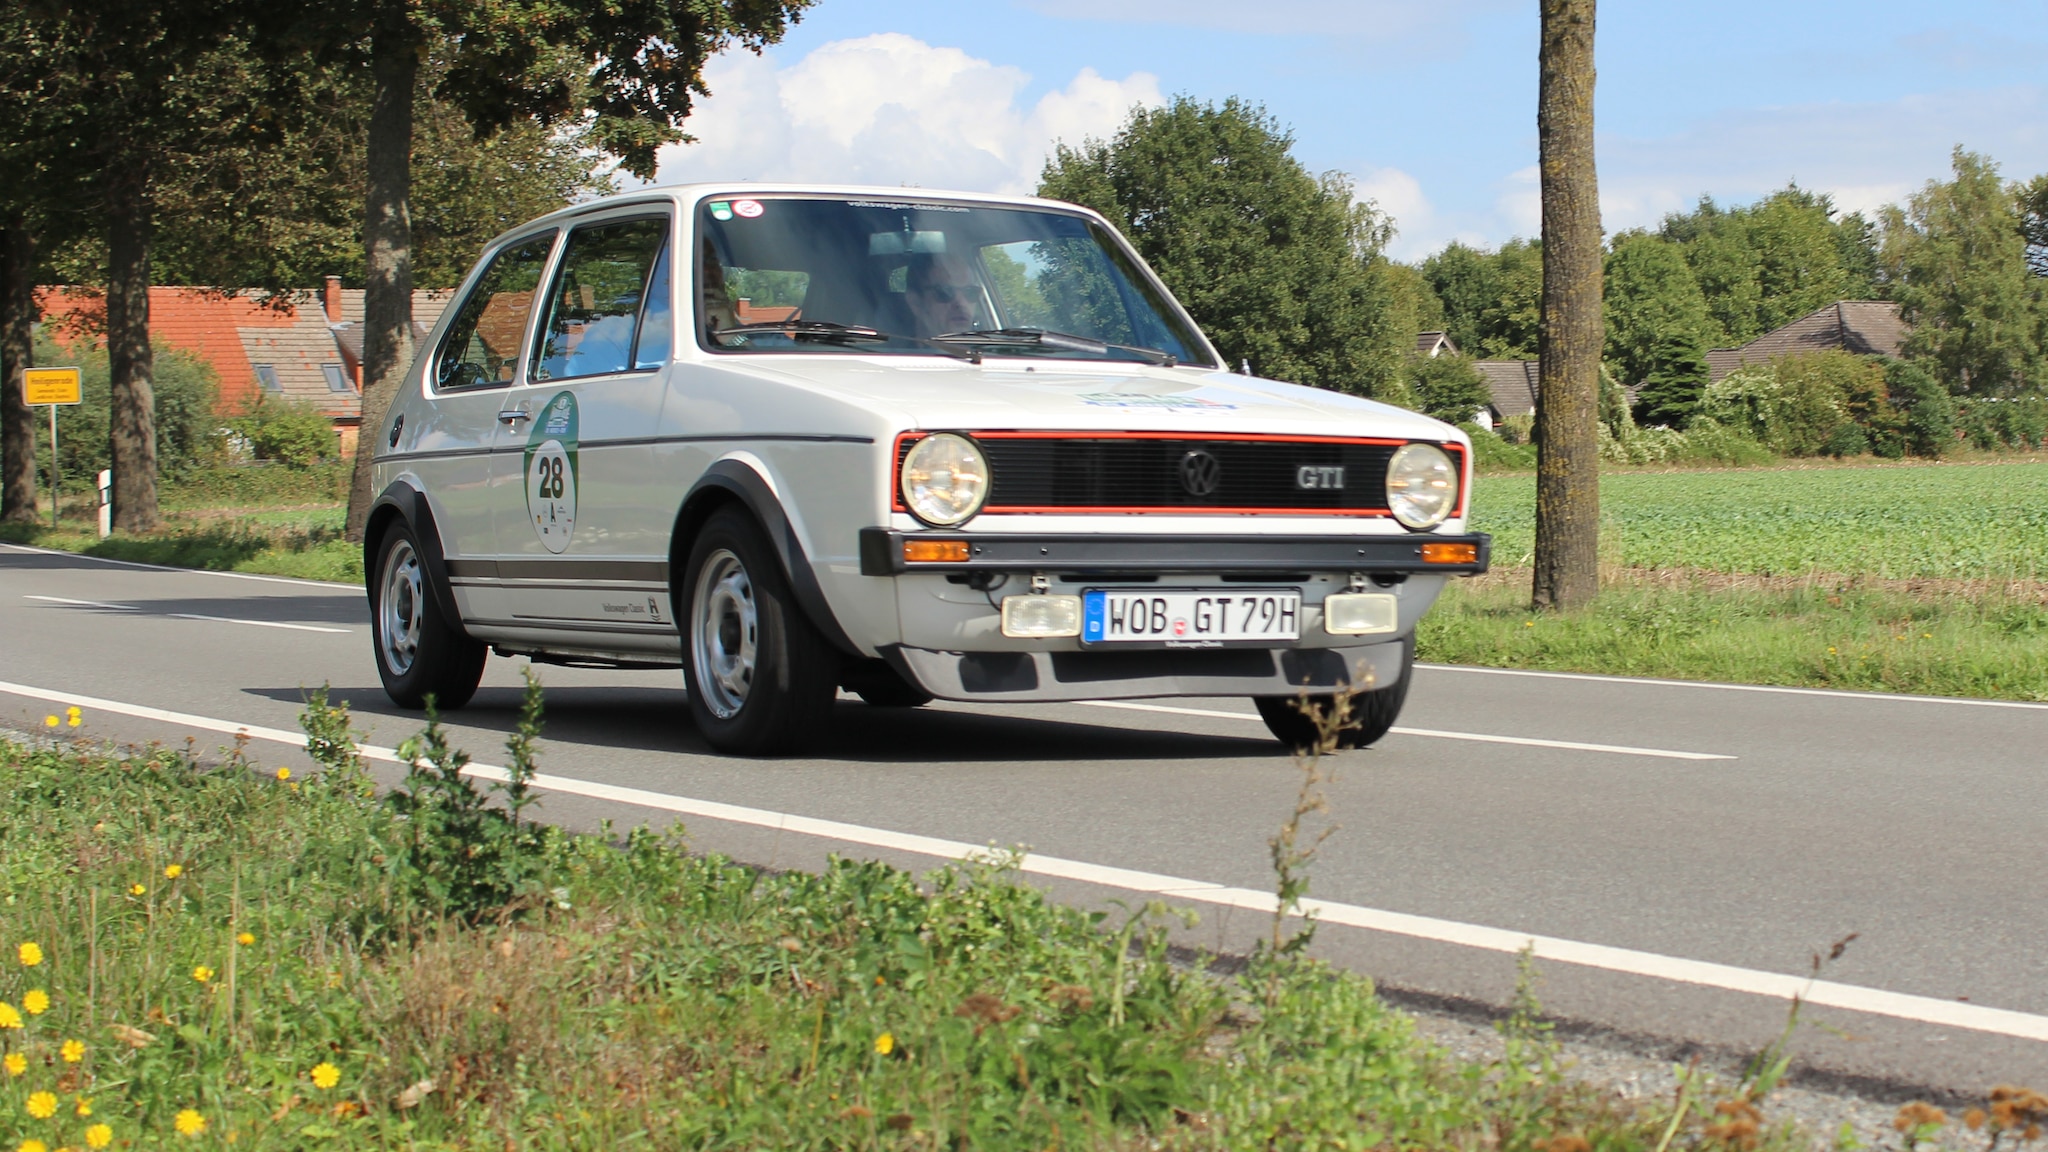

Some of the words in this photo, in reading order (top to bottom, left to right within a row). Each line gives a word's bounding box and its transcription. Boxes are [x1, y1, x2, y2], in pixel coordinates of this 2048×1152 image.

[539, 456, 564, 499] 28
[1297, 466, 1345, 489] GTI
[1109, 598, 1168, 633] WOB
[1195, 598, 1232, 633] GT
[1242, 597, 1296, 633] 79H
